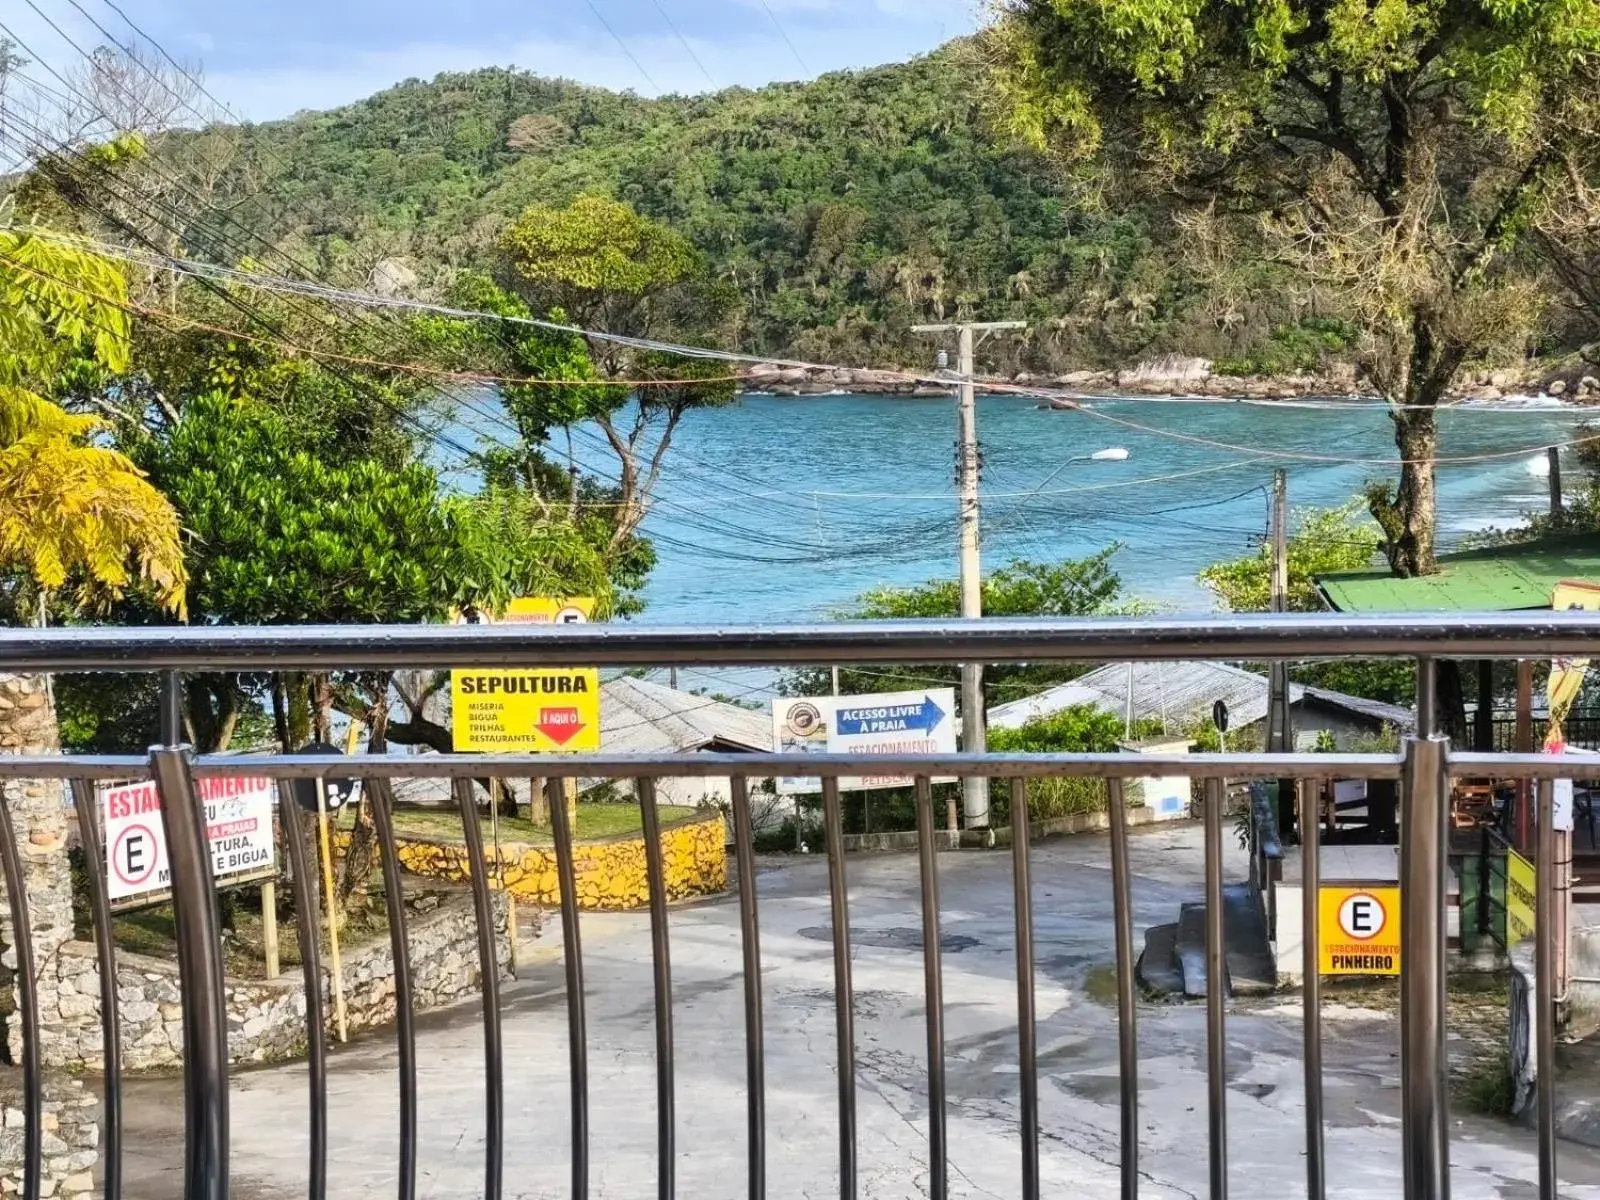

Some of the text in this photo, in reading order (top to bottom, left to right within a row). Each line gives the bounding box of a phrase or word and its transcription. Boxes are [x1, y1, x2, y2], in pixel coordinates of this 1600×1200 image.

[461, 676, 588, 694] SEPULTURA
[468, 703, 504, 711] MISERIA
[843, 705, 922, 721] ACESSO LIVRE
[469, 724, 505, 732] TRILHAS
[871, 720, 907, 732] PRAIA
[469, 734, 536, 743] RESTAURANTES
[848, 739, 937, 755] ESTACIONAMENTO
[126, 836, 144, 874] E
[217, 848, 268, 870] E BIGUA
[1352, 902, 1371, 931] E
[1332, 955, 1392, 969] PINHEIRO
